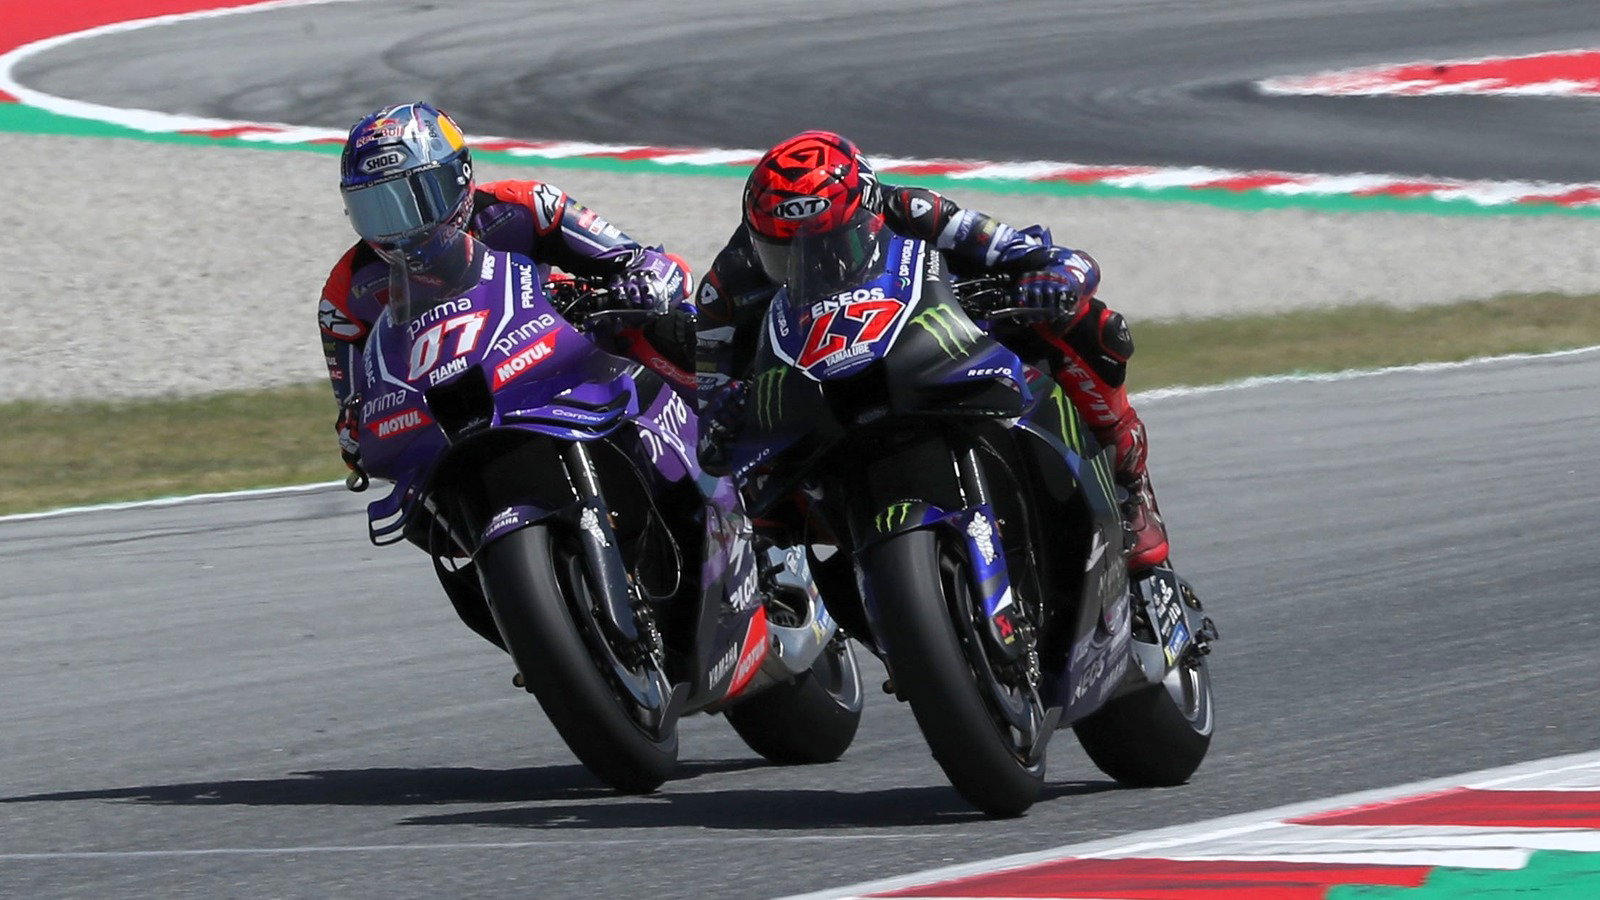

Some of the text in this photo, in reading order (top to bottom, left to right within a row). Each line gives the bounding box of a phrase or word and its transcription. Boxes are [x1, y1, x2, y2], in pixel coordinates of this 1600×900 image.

[366, 153, 400, 171] SHOEI
[775, 198, 827, 217] KYT
[899, 239, 914, 277] DP WORLD
[519, 264, 534, 309] PRAMAC
[811, 287, 886, 319] ENEOS
[406, 298, 473, 341] prima
[493, 313, 556, 357] prima
[407, 311, 487, 381] 07
[496, 341, 553, 383] MOTUL
[824, 343, 870, 367] YAMALUBE
[428, 356, 469, 386] FIAMM
[362, 389, 407, 424] prima
[552, 408, 605, 422] Corpay
[377, 410, 422, 438] MOTUL
